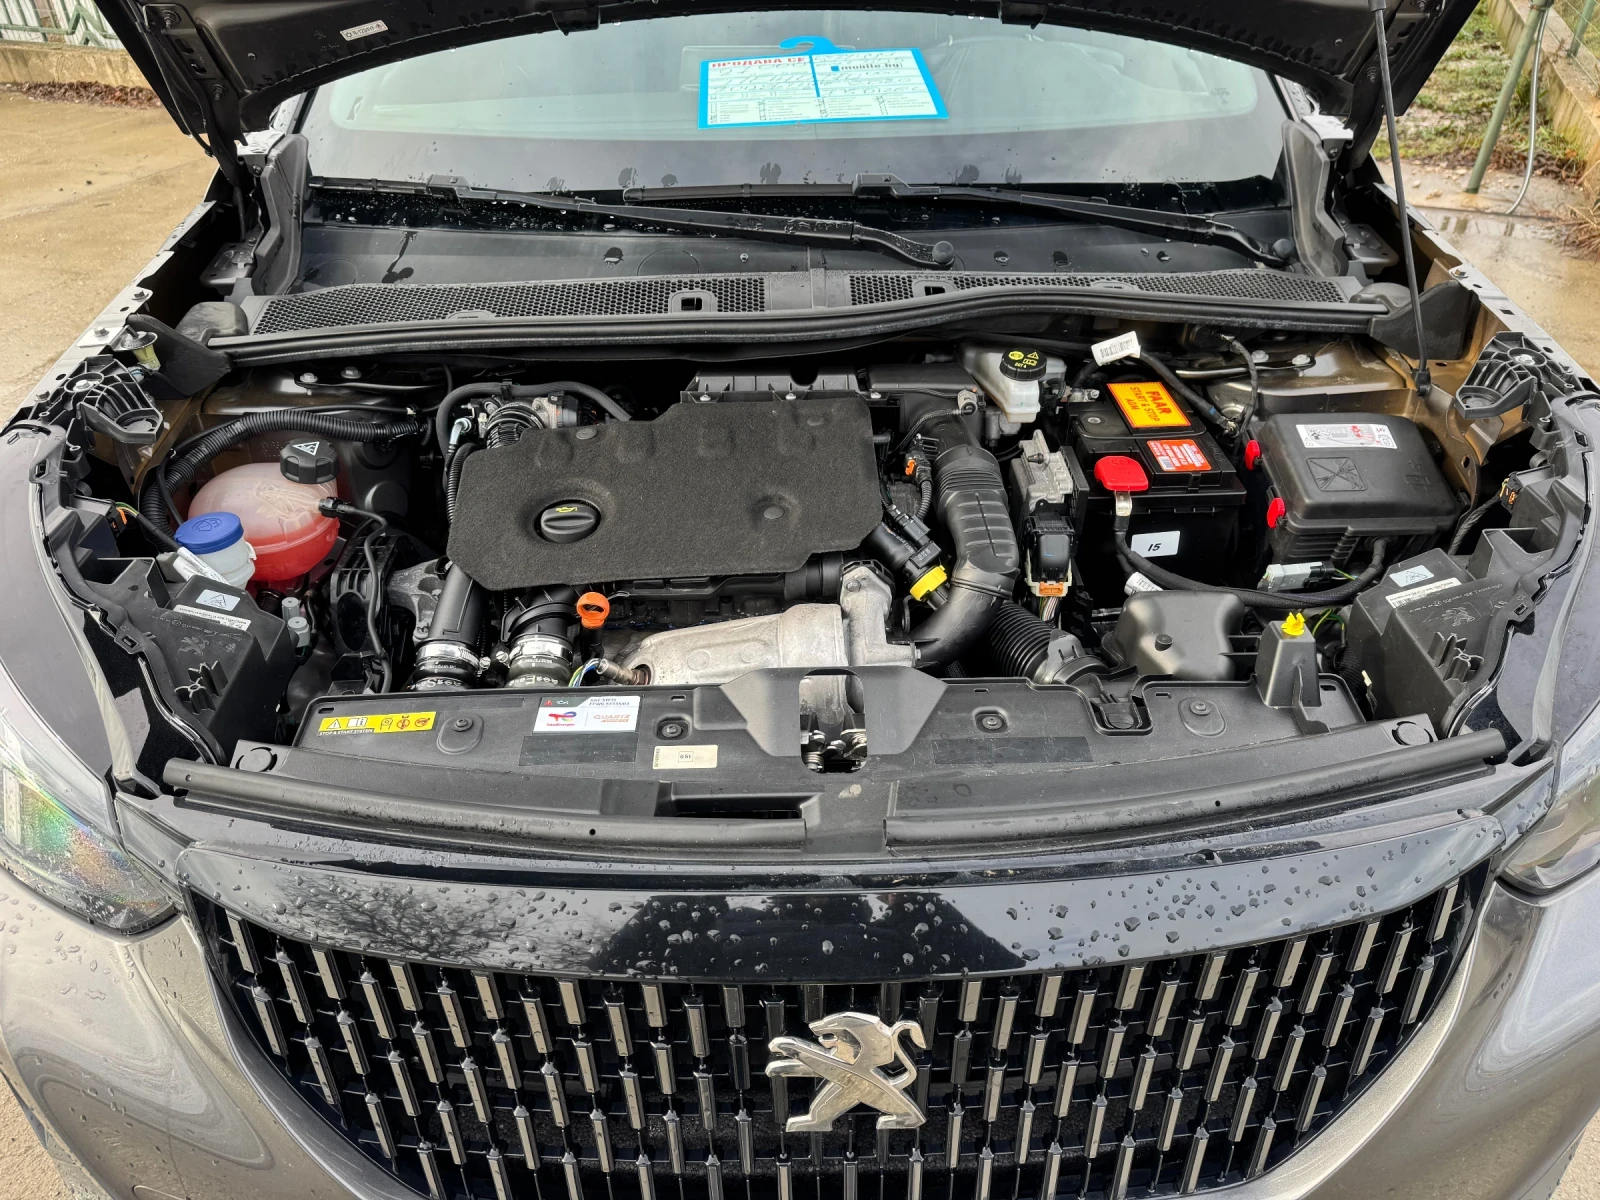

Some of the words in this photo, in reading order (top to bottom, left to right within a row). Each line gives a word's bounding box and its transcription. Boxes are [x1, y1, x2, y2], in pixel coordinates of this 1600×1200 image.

[711, 58, 783, 68] ПРОДАВА
[841, 63, 900, 71] mobile.bg
[1125, 398, 1141, 410] AGM
[1130, 386, 1148, 402] START
[1144, 408, 1161, 422] STOP
[1145, 391, 1173, 414] FAAR
[1147, 542, 1162, 552] 15
